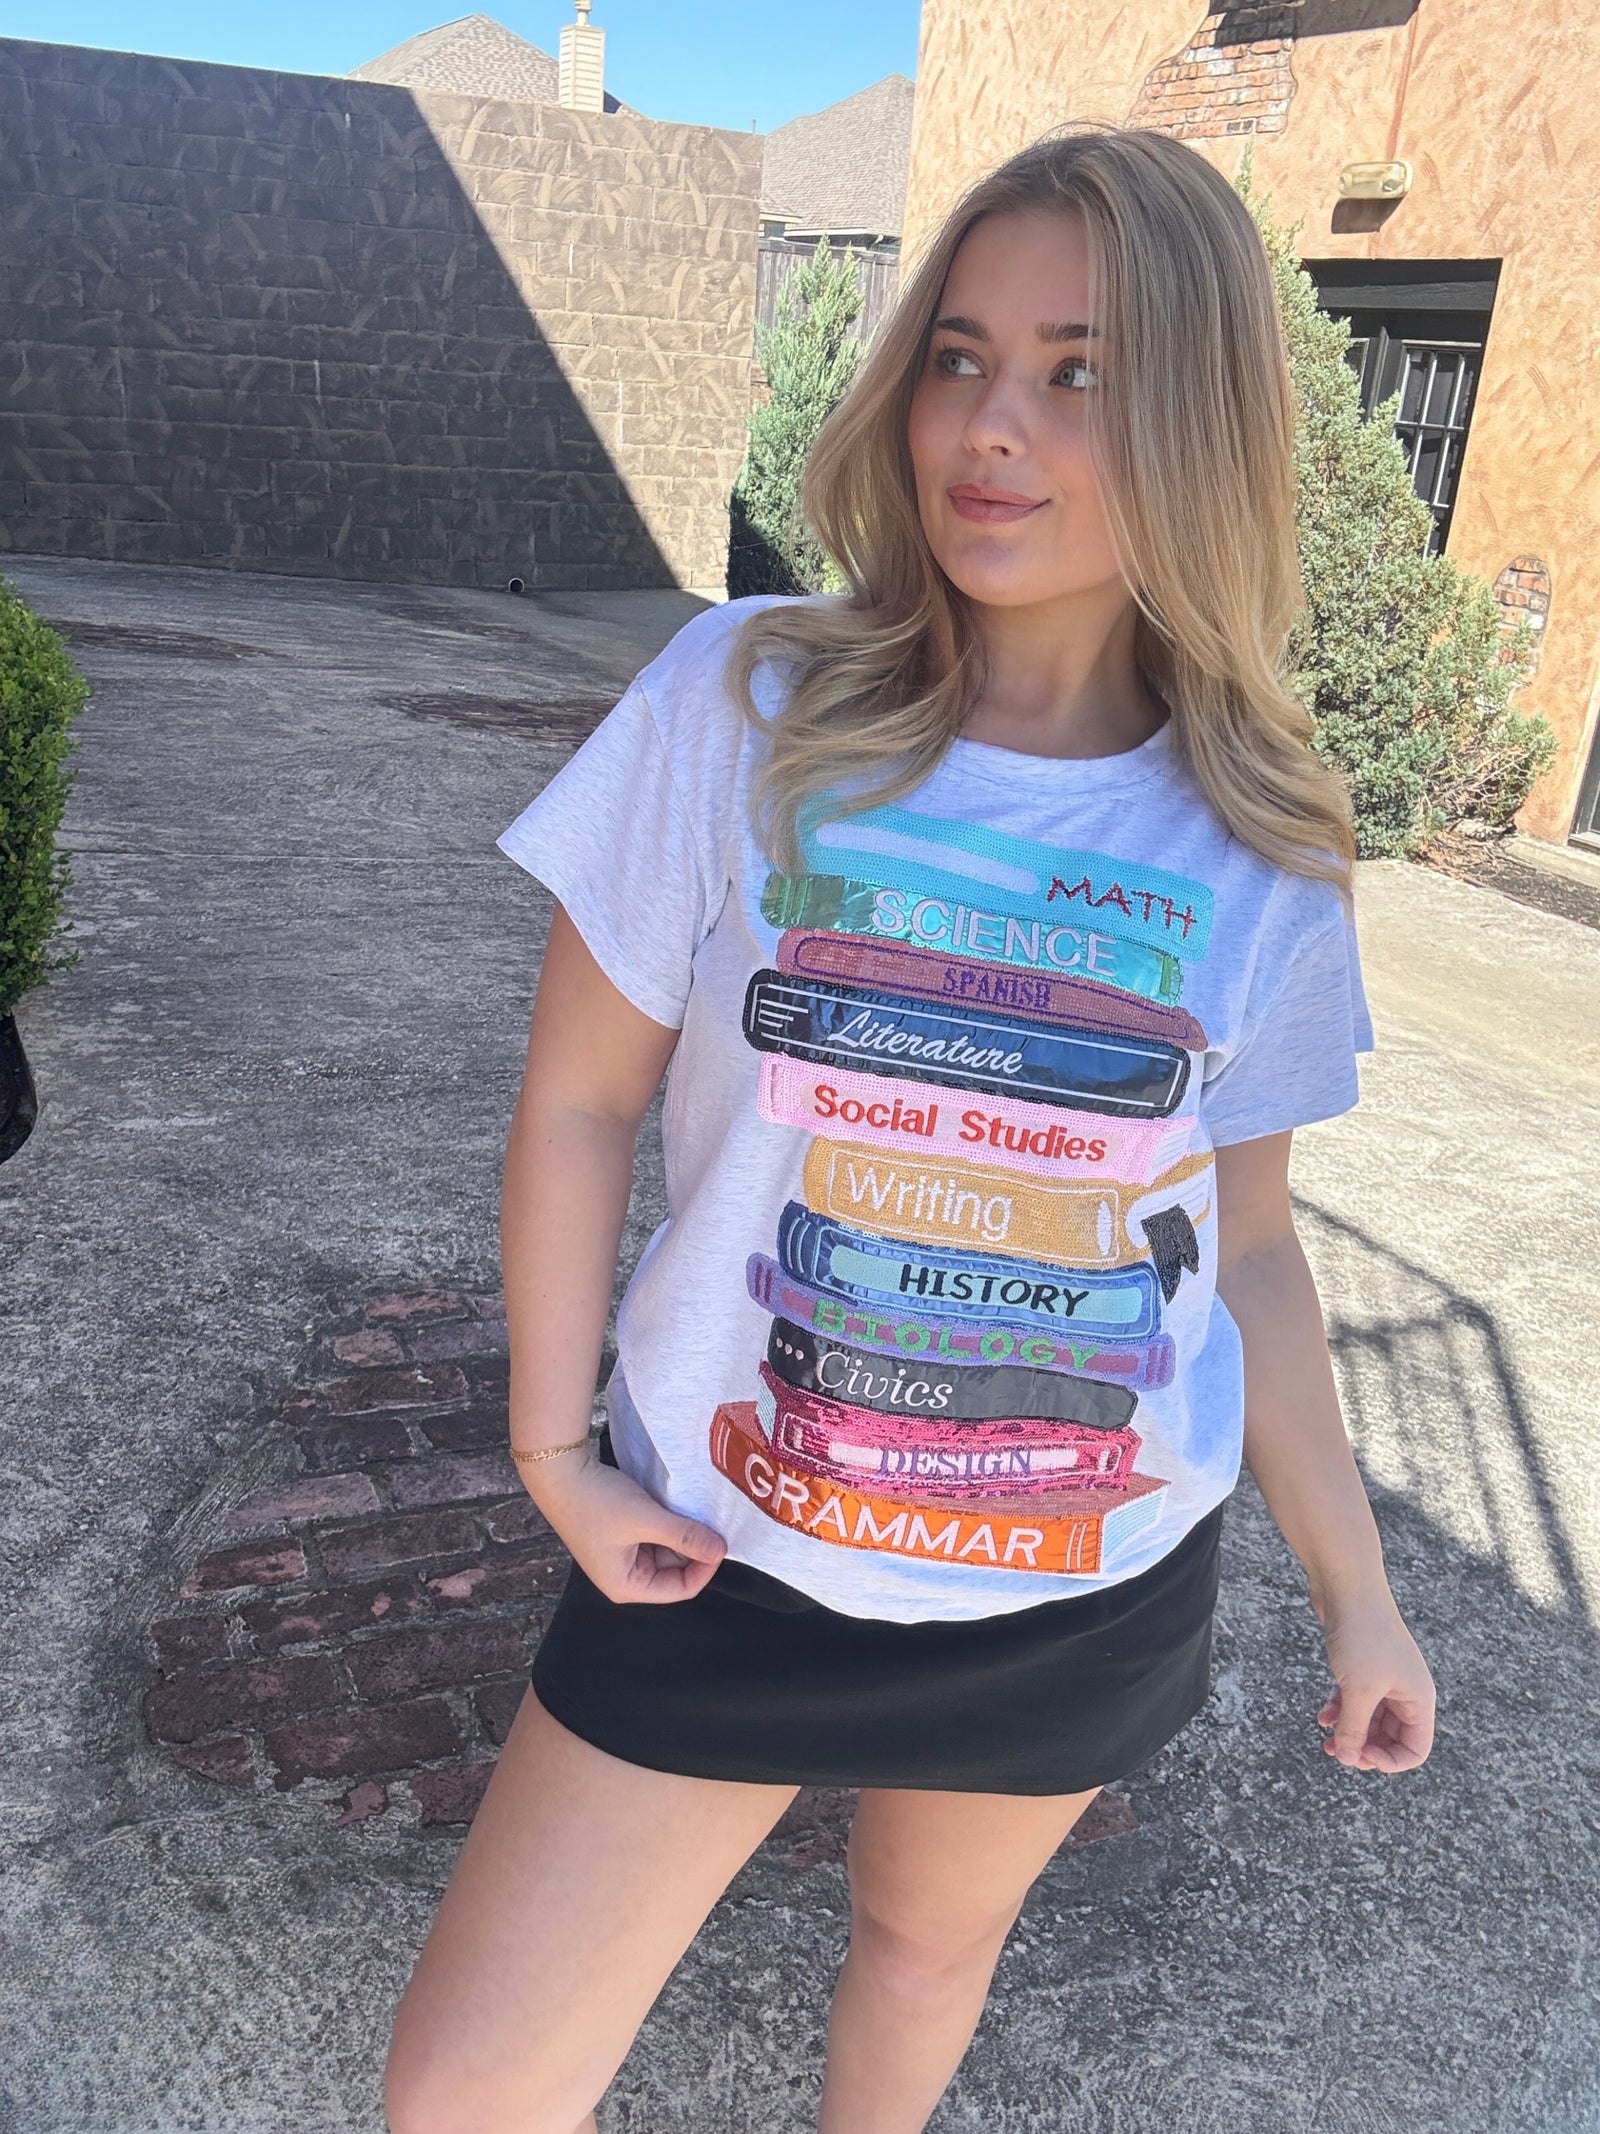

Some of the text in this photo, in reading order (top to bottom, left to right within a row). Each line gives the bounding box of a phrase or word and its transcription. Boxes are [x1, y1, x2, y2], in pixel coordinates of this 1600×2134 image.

[870, 889, 1118, 977] SCIENCE
[1046, 876, 1196, 939] MATH
[827, 1009, 1023, 1075] Literature
[814, 1084, 1108, 1162] Social Studies
[846, 1162, 1014, 1241] Writing
[899, 1263, 1090, 1317] HISTORY
[811, 1299, 1101, 1370] BIOLOGY
[816, 1351, 954, 1409] Civics
[880, 1445, 1034, 1478] DESIGN
[744, 1452, 1045, 1566] GRAMMAR
